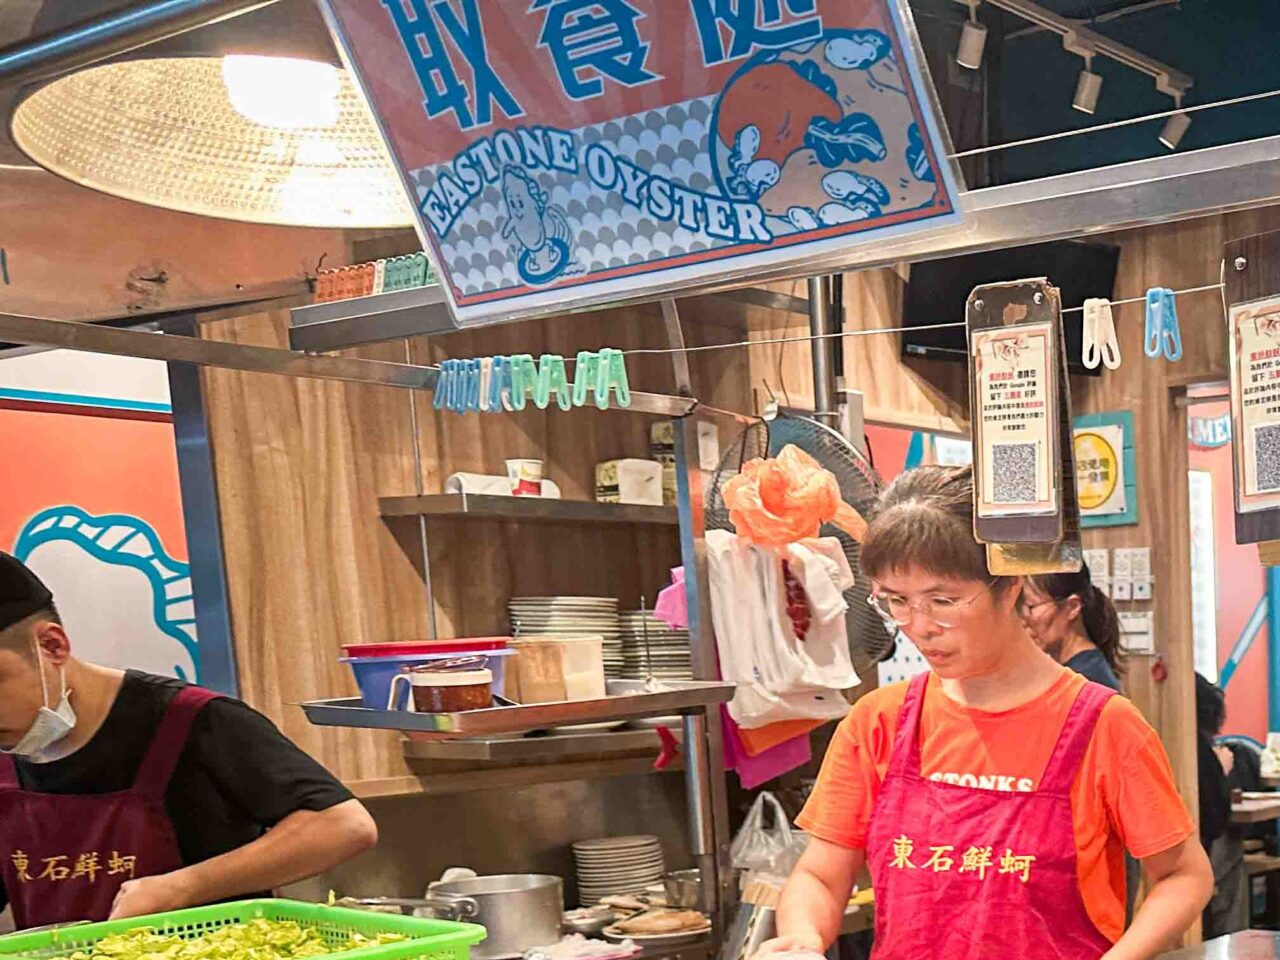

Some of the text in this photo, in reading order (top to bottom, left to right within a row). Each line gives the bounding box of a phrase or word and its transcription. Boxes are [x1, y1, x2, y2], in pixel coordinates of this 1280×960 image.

[420, 126, 776, 243] EASTONE OYSTER
[10, 850, 137, 883] 東石鮮蚵
[889, 834, 1037, 883] 東石鮮蚵
